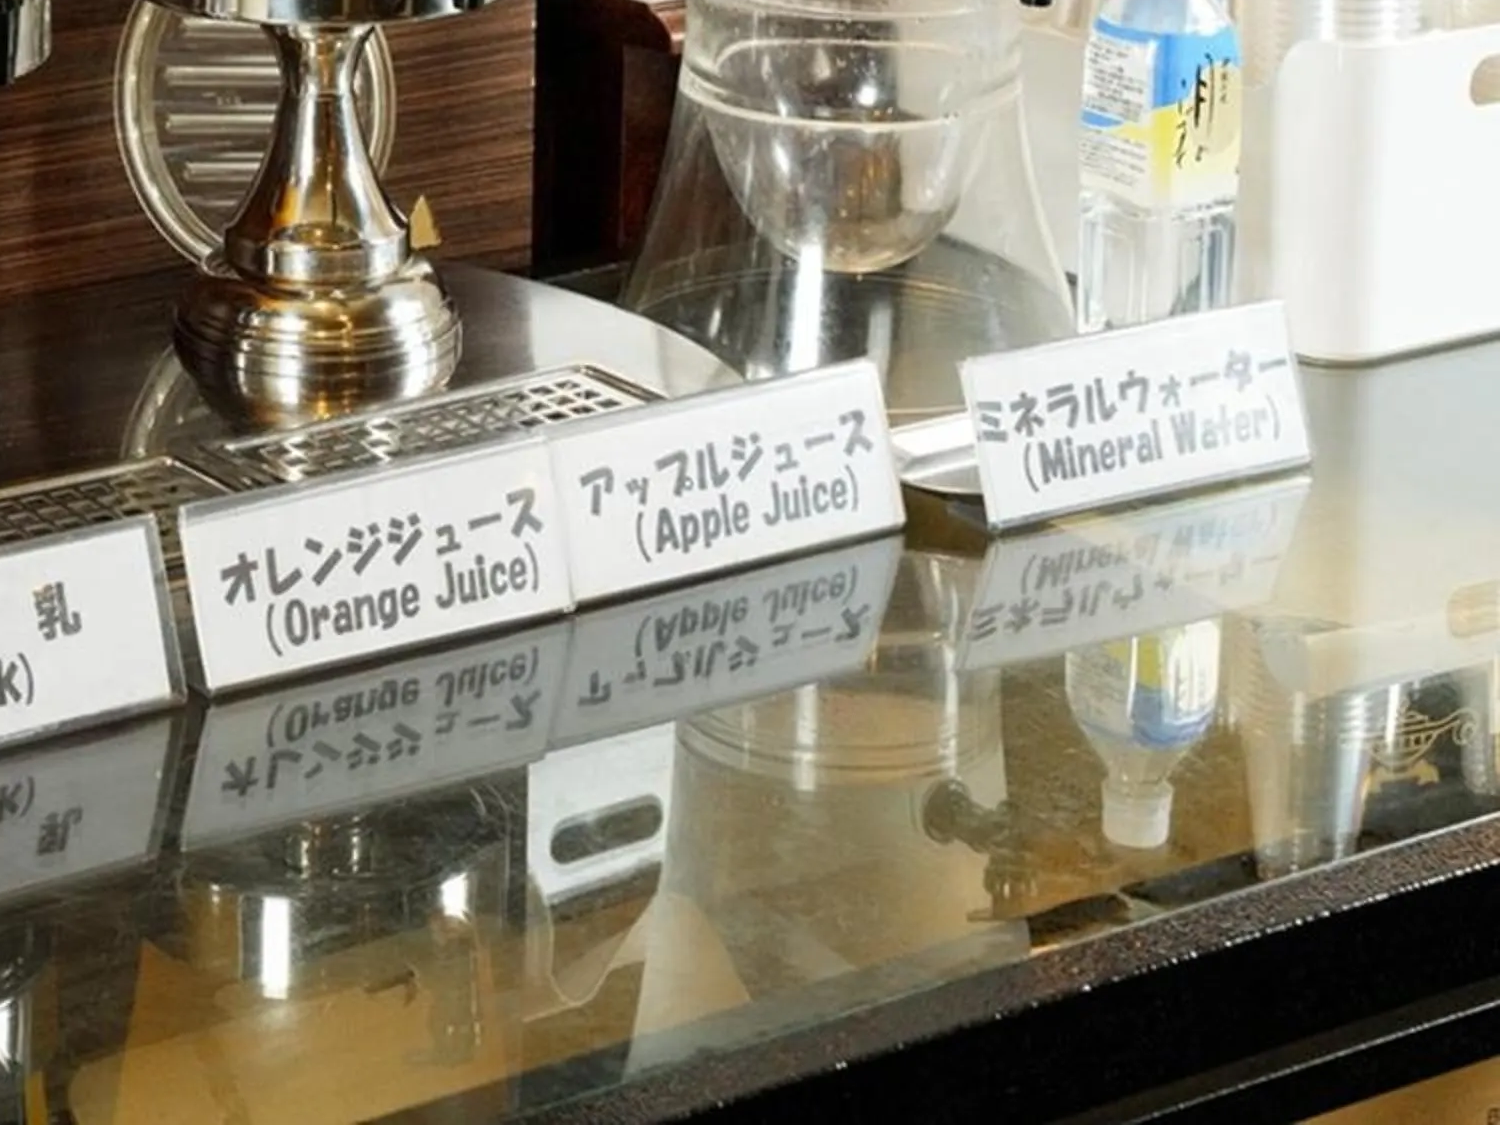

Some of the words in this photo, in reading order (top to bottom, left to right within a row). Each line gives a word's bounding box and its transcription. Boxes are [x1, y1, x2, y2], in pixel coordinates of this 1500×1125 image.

[976, 350, 1287, 442] ミネラルウォーター
[1023, 420, 1163, 492] (Mineral
[1171, 395, 1281, 453] Water)
[580, 410, 873, 515] アップルジュース
[220, 488, 544, 605] オレンジジュース
[636, 493, 749, 562] (Apple
[763, 465, 858, 526] Juice)
[266, 583, 419, 656] (Orange
[436, 542, 538, 609] Juice)
